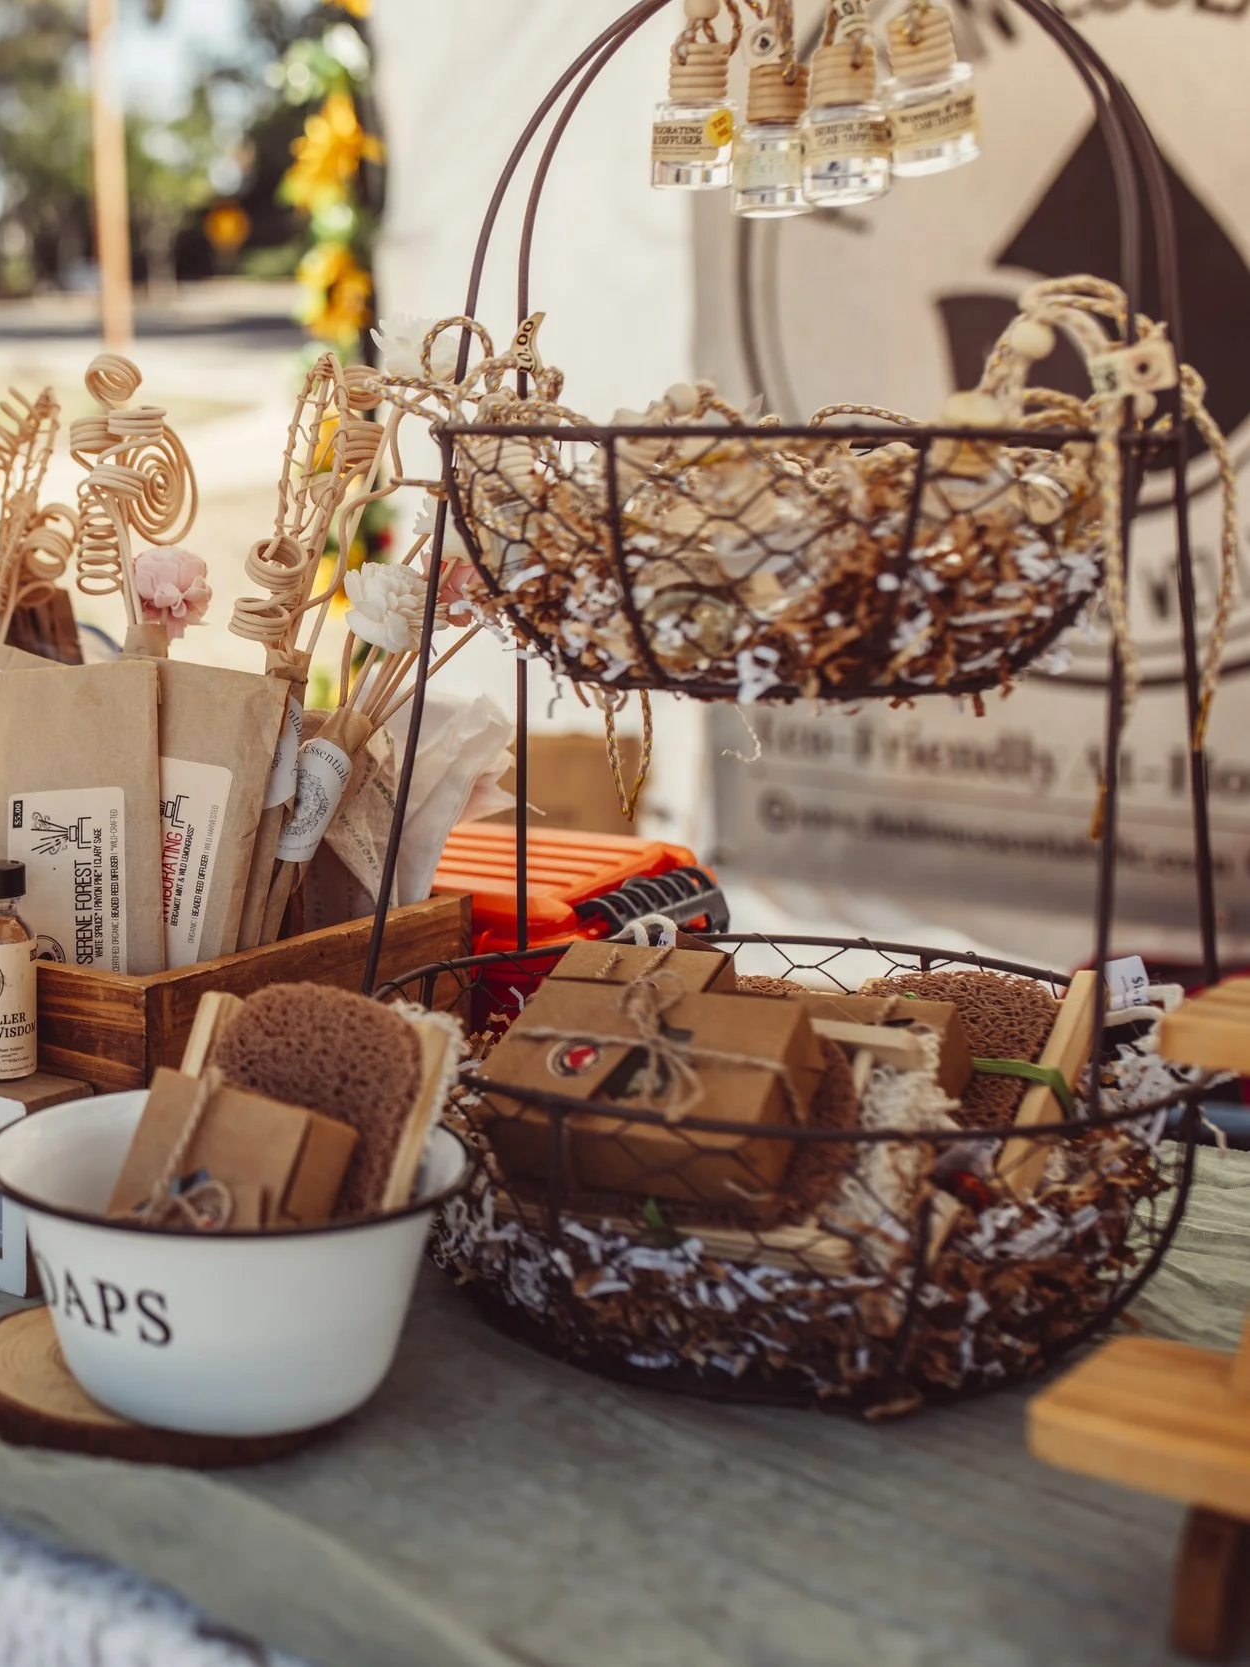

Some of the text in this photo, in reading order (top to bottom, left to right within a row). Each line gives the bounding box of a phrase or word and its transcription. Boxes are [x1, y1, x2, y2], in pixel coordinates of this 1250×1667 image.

[14, 802, 22, 826] $5.00
[93, 828, 102, 843] SAGE
[93, 845, 102, 864] CLARY
[198, 854, 209, 879] DIFFUSER
[110, 855, 119, 881] DIFFUSER
[163, 831, 184, 923] VIGORATING
[179, 862, 189, 877] WILD
[110, 882, 119, 896] REED
[176, 883, 184, 898] MINT
[196, 878, 204, 893] REED
[74, 860, 94, 965] SERENE FOREST
[110, 897, 119, 918] BEADED
[170, 898, 182, 927] BERGAMOT
[192, 893, 202, 917] BEADED
[111, 921, 119, 945] ORGANIC
[94, 939, 103, 958] WHITE
[111, 946, 120, 972] CERTIFIED
[33, 1250, 173, 1349] APS
